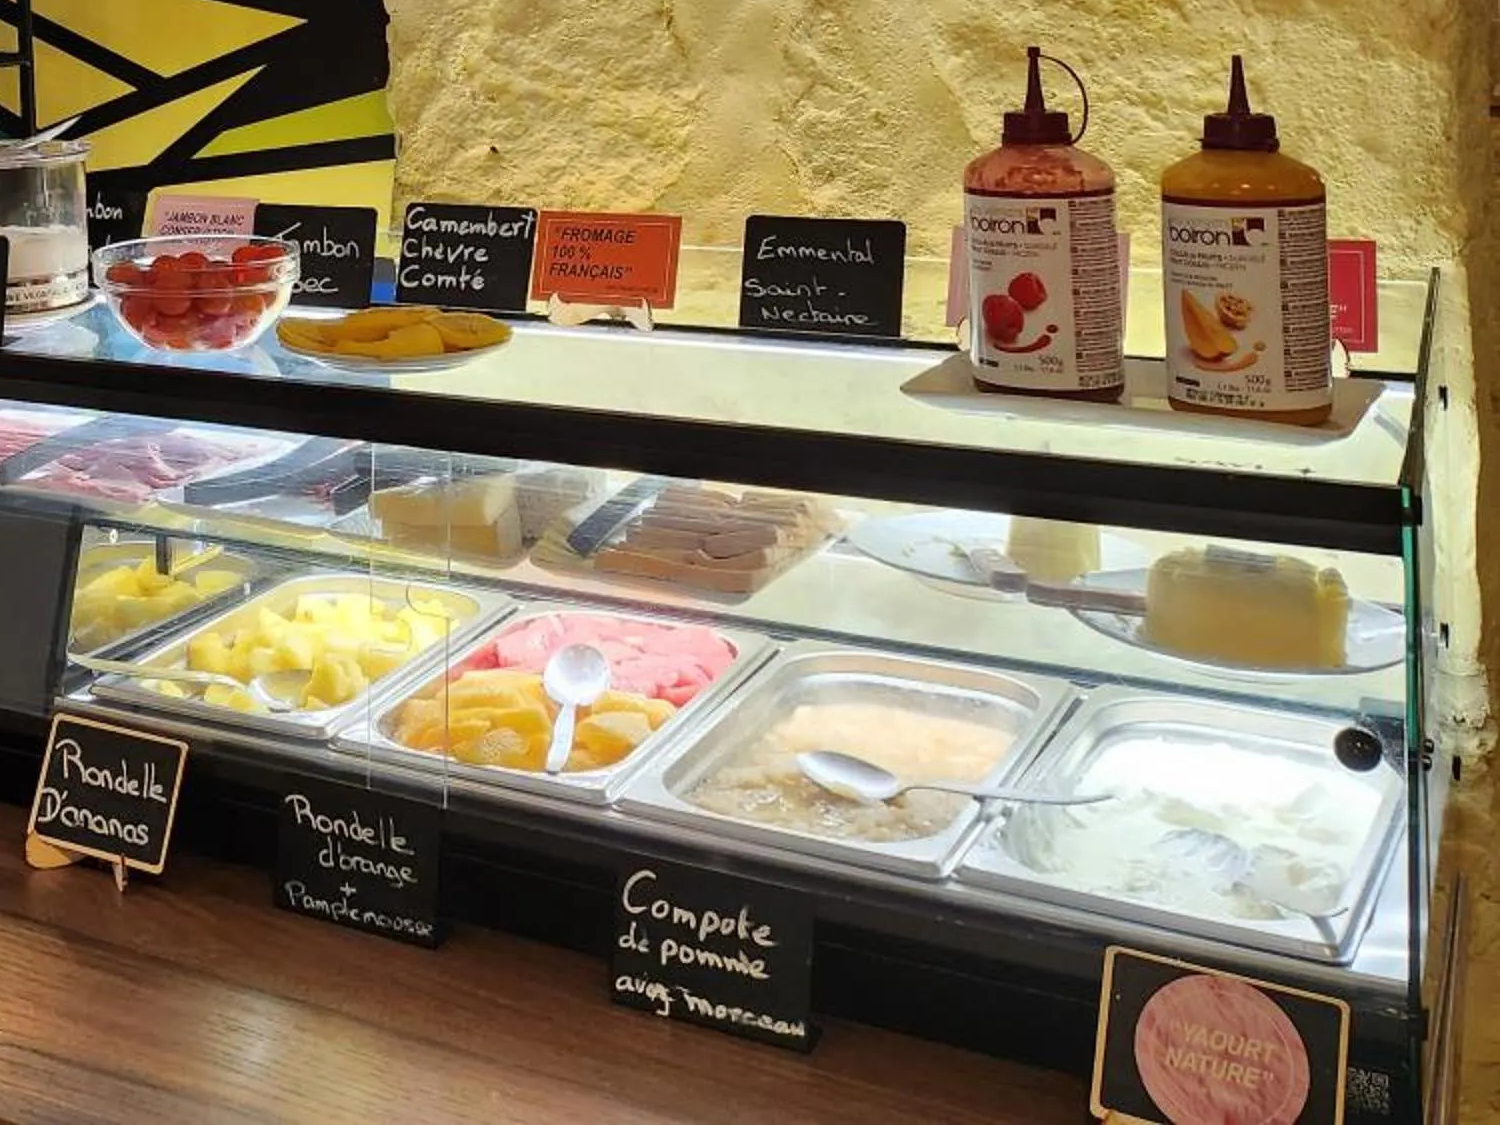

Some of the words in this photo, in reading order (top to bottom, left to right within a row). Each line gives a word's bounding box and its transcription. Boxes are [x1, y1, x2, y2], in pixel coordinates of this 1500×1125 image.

[209, 214, 245, 227] BLANC
[405, 206, 535, 241] Camembert
[1169, 220, 1232, 246] boiron
[402, 237, 489, 264] Chèvre
[552, 245, 575, 259] 100
[578, 246, 593, 259] %
[756, 234, 875, 265] Emmental
[400, 264, 485, 292] Comté
[55, 738, 168, 804] Rondelle
[284, 794, 416, 856] Rondelle
[622, 869, 779, 948] Compote
[618, 921, 650, 954] de
